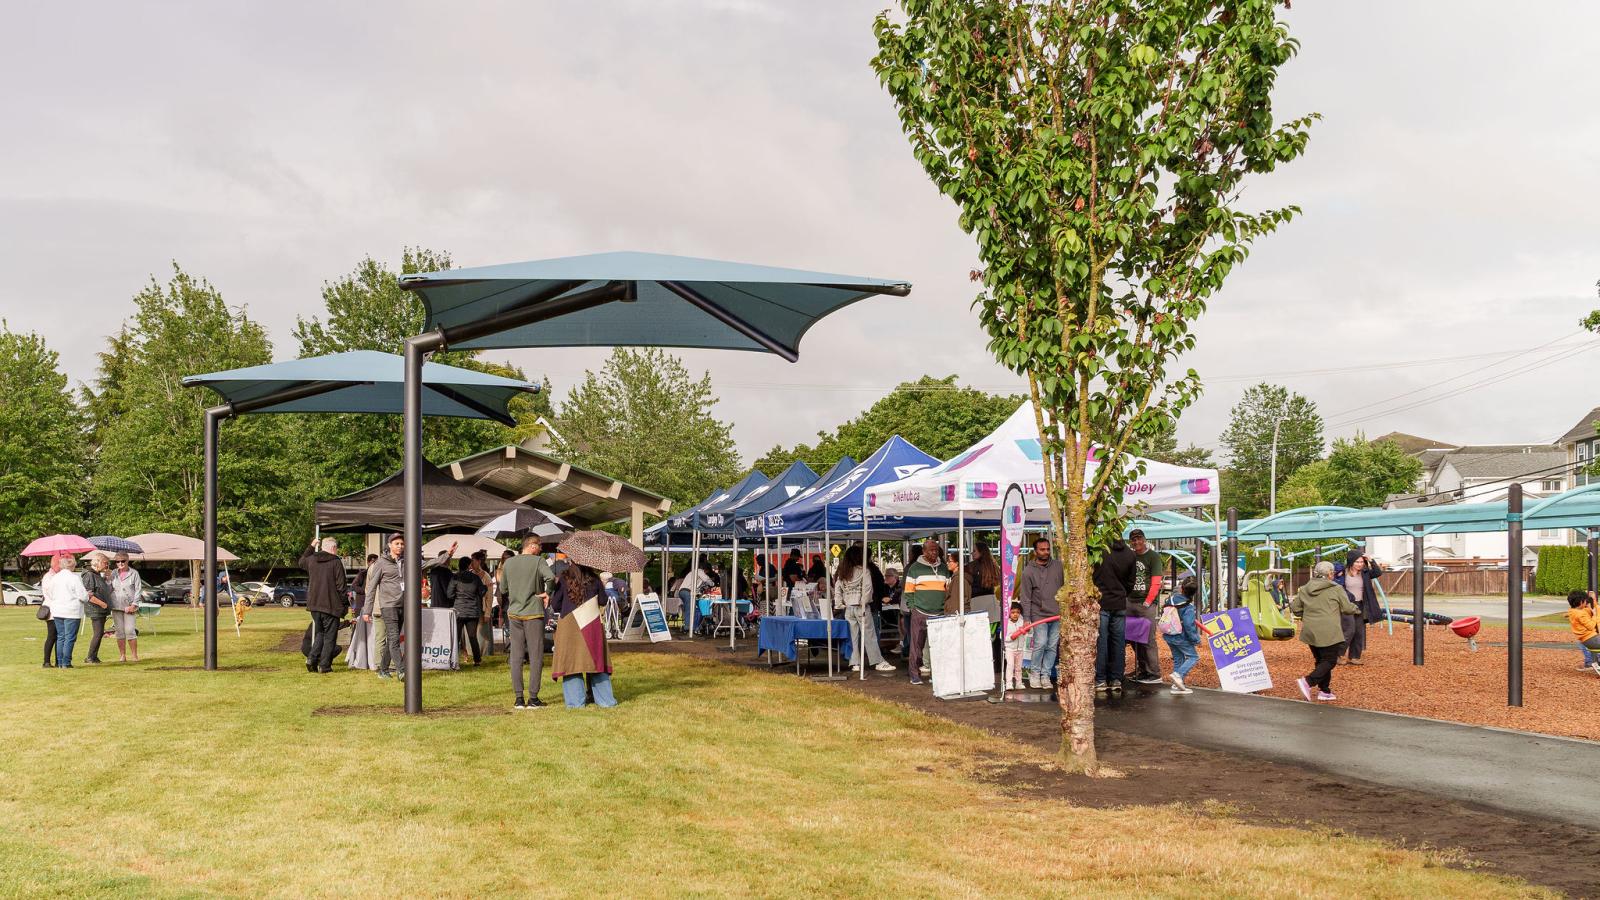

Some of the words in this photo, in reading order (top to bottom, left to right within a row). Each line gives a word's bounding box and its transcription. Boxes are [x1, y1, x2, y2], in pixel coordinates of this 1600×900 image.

[893, 490, 920, 503] bikehub.ca
[1213, 631, 1238, 649] GIVE
[1222, 634, 1253, 655] SPACE
